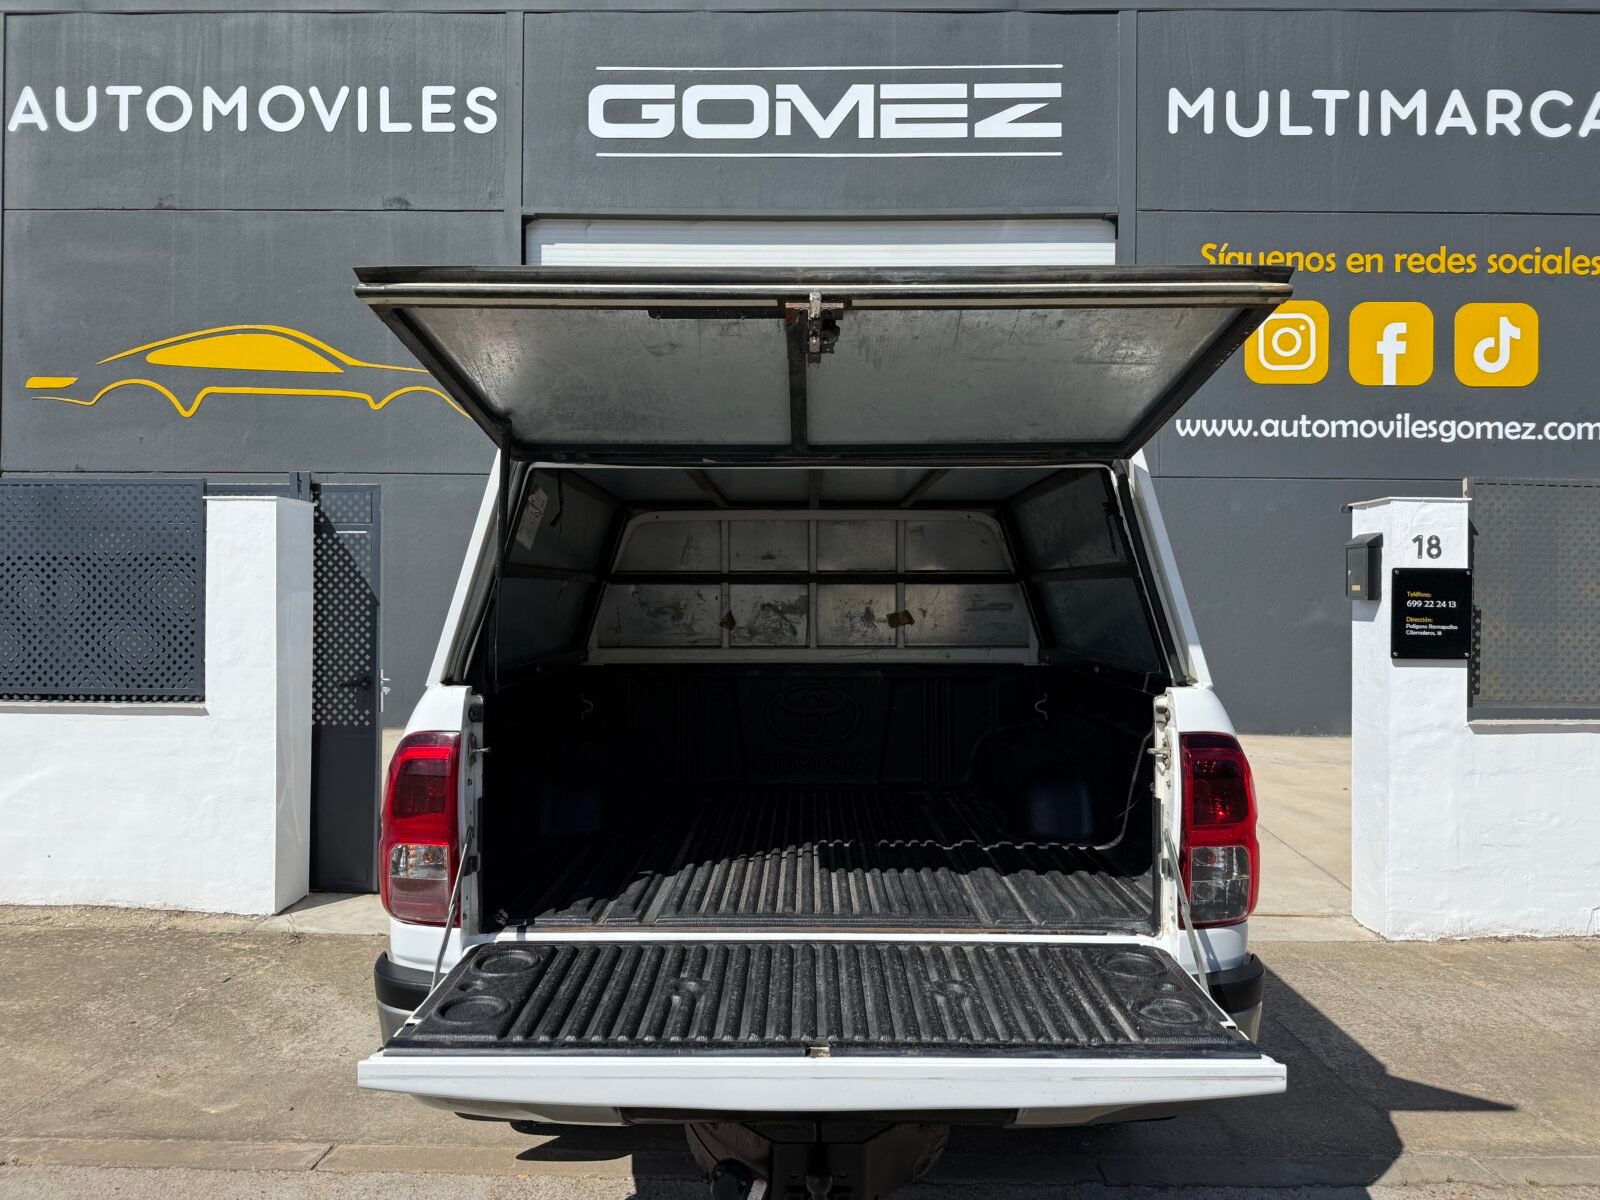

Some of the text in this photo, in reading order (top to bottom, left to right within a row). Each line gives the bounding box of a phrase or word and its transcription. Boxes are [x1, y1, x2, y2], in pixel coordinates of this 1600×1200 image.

[8, 85, 497, 133] AUTOMOVILES
[588, 82, 1062, 139] GOMEZ
[1346, 252, 1384, 272] en
[1395, 246, 1477, 274] redes
[1488, 246, 1600, 276] sociales
[1176, 413, 1600, 443] www.automovilesgomez.com
[1412, 534, 1442, 559] 18
[1406, 600, 1457, 609] 699 22 24 13
